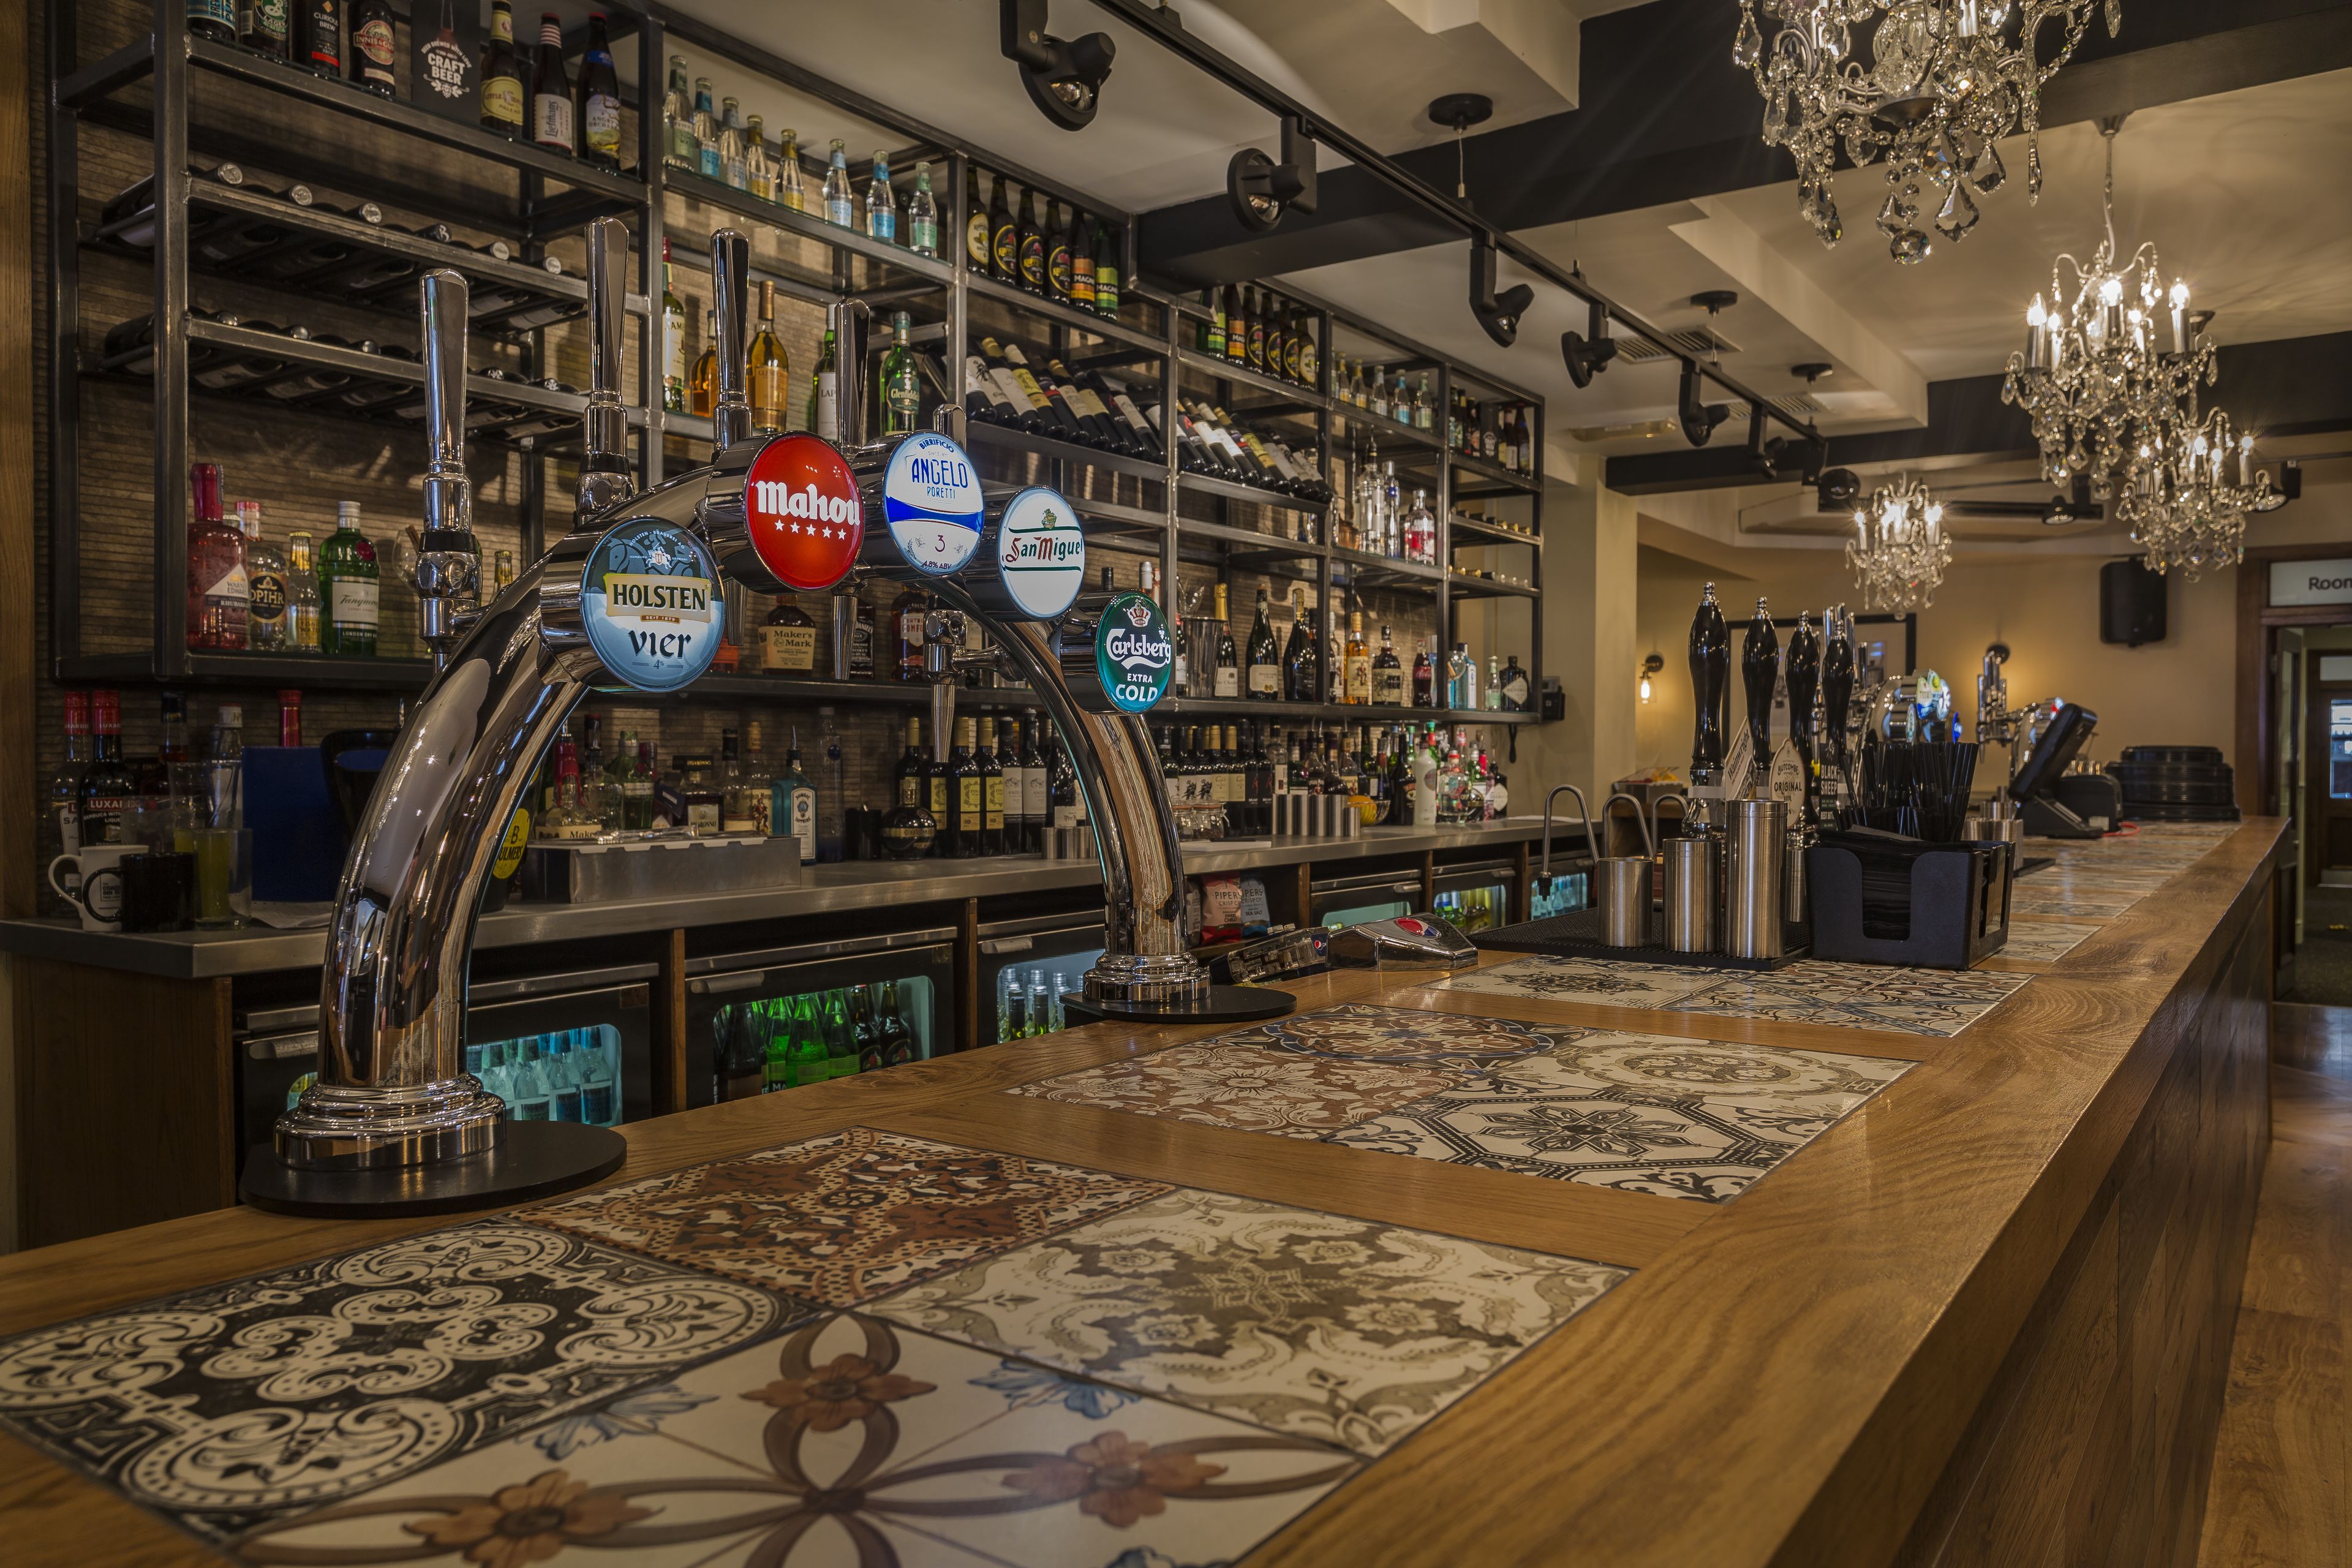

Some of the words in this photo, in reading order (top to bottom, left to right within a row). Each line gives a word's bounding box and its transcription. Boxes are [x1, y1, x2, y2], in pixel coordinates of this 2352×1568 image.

[319, 21, 336, 31] BREW
[428, 53, 466, 75] CRAFT
[431, 66, 462, 85] BEER
[821, 389, 836, 398] LAP
[919, 439, 954, 453] BIRRIFICIO
[911, 458, 968, 489] ANGELO
[927, 486, 956, 499] PORETTI
[755, 480, 861, 526] Mahou
[628, 530, 649, 547] HOLSTEN
[935, 534, 946, 552] 3
[921, 560, 938, 568] 4.8%
[613, 584, 707, 611] HOLSTEN
[774, 630, 812, 639] Maker's
[628, 630, 692, 659] vier
[1106, 628, 1172, 665] Carlsberg
[653, 659, 665, 669] 4%
[1126, 673, 1153, 684] EXTRA
[1115, 684, 1158, 703] COLD
[1727, 729, 1751, 780] Wainwright
[1777, 764, 1800, 776] BUTCOMBE
[1821, 764, 1838, 780] BLACK
[1774, 782, 1803, 794] ORIGINAL
[1820, 781, 1837, 796] SHEEP
